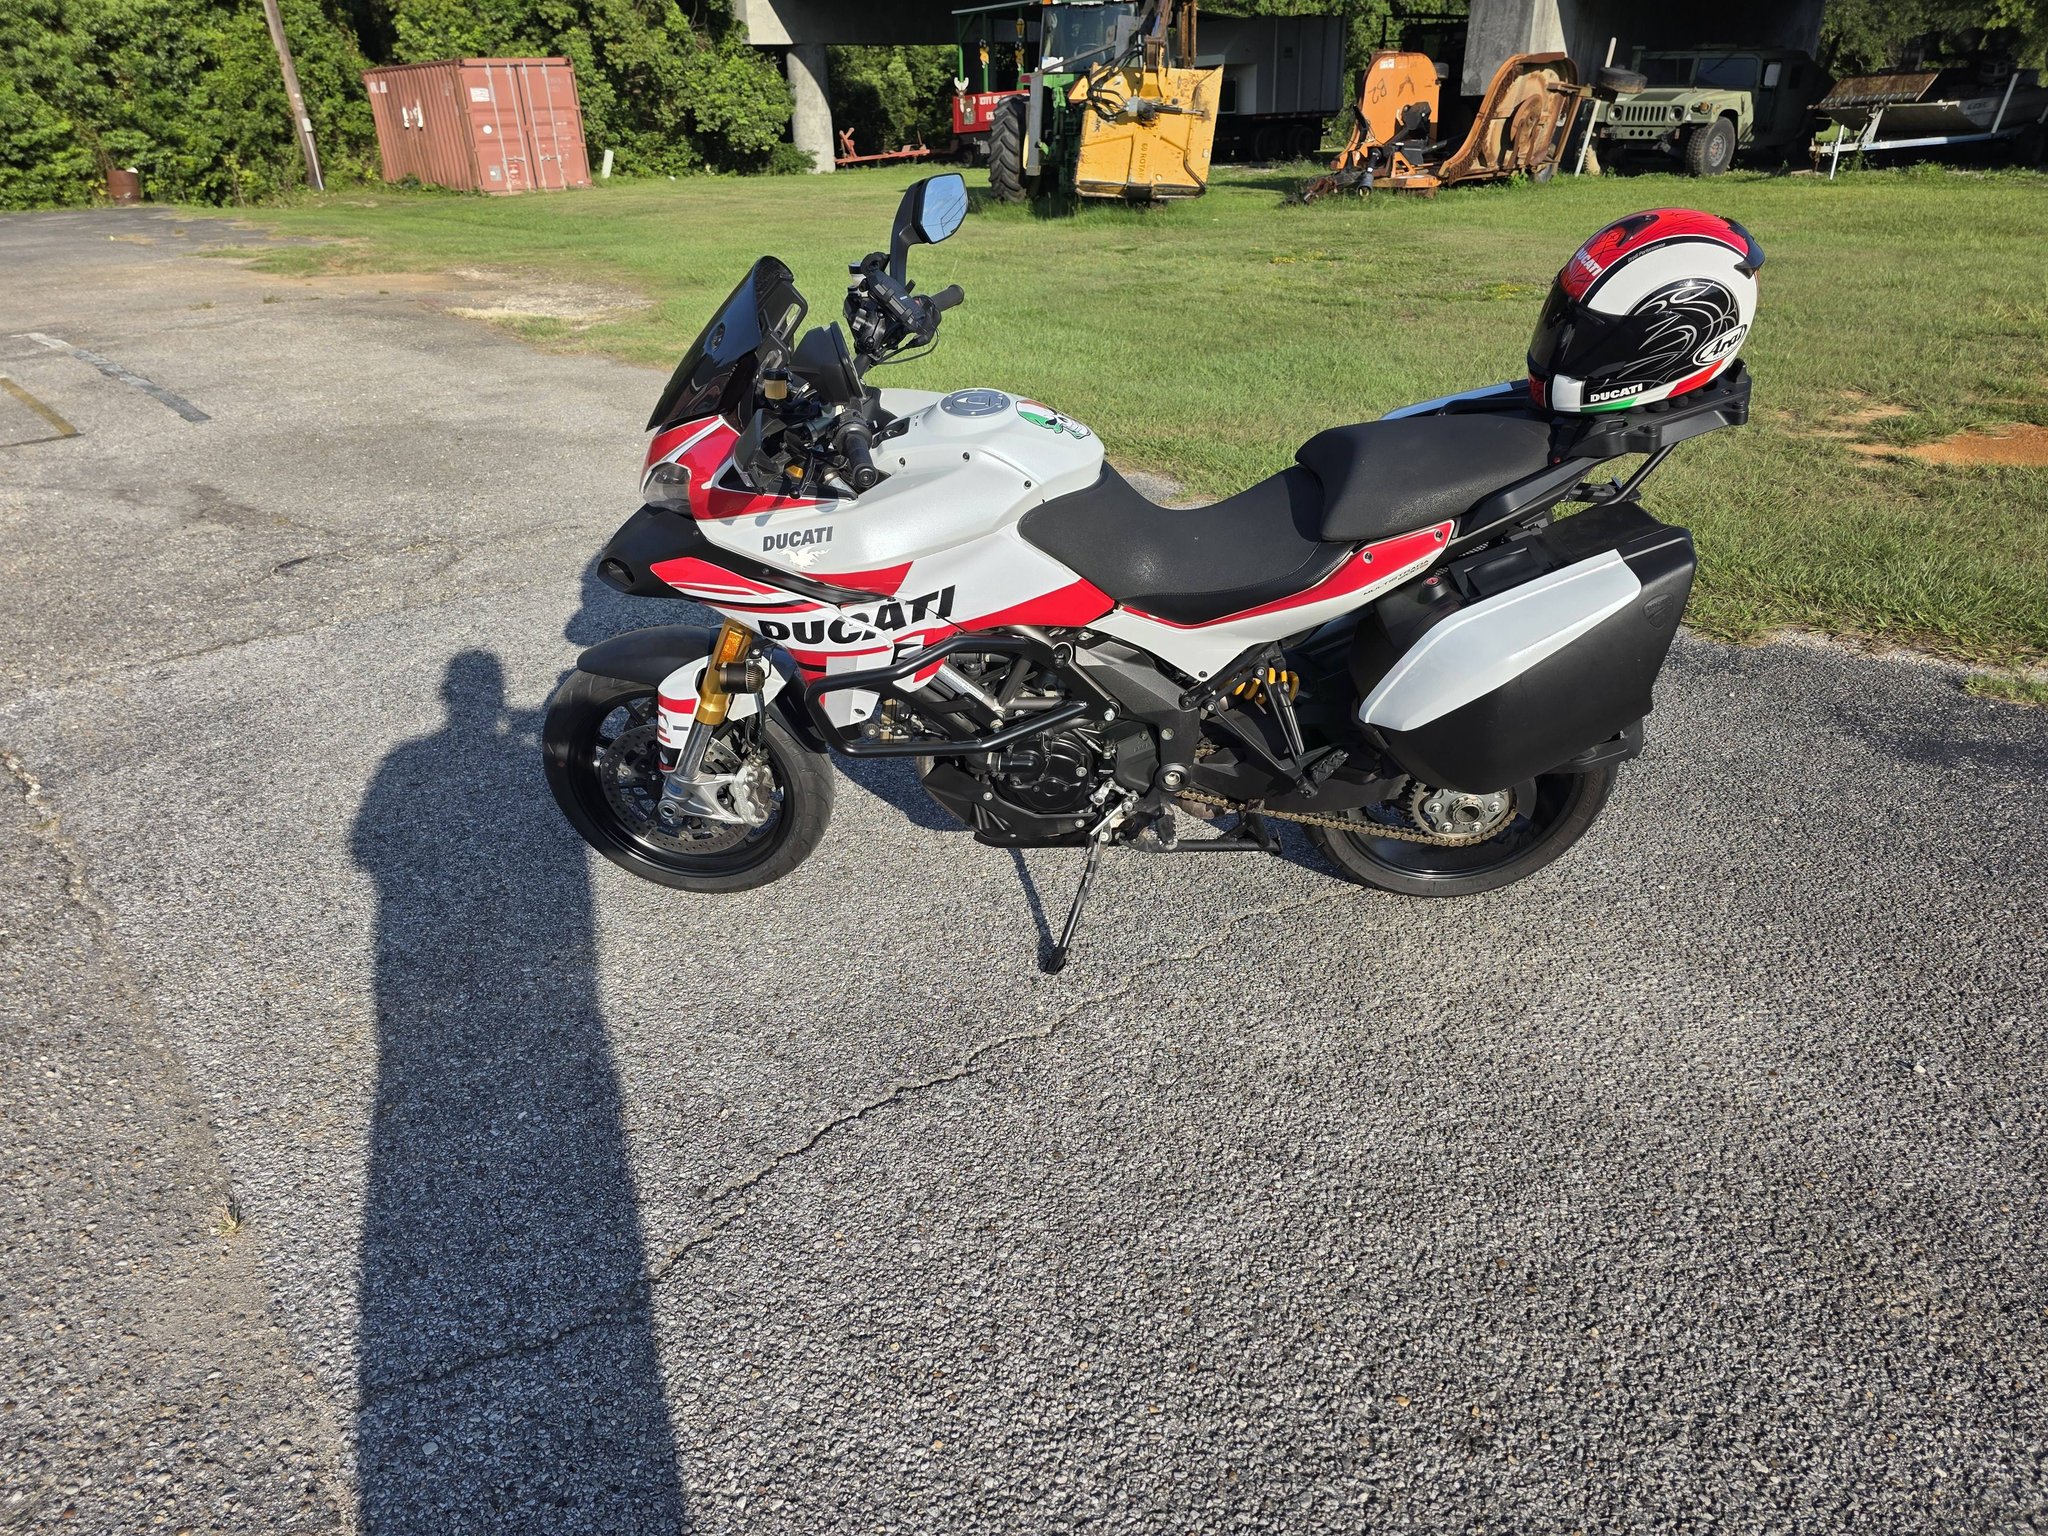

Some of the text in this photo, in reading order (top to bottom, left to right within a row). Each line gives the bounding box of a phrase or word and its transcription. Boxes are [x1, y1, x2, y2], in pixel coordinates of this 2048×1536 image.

[1590, 382, 1643, 403] DUCATI
[762, 526, 834, 552] DUCATI
[757, 584, 956, 645] DUCATI
